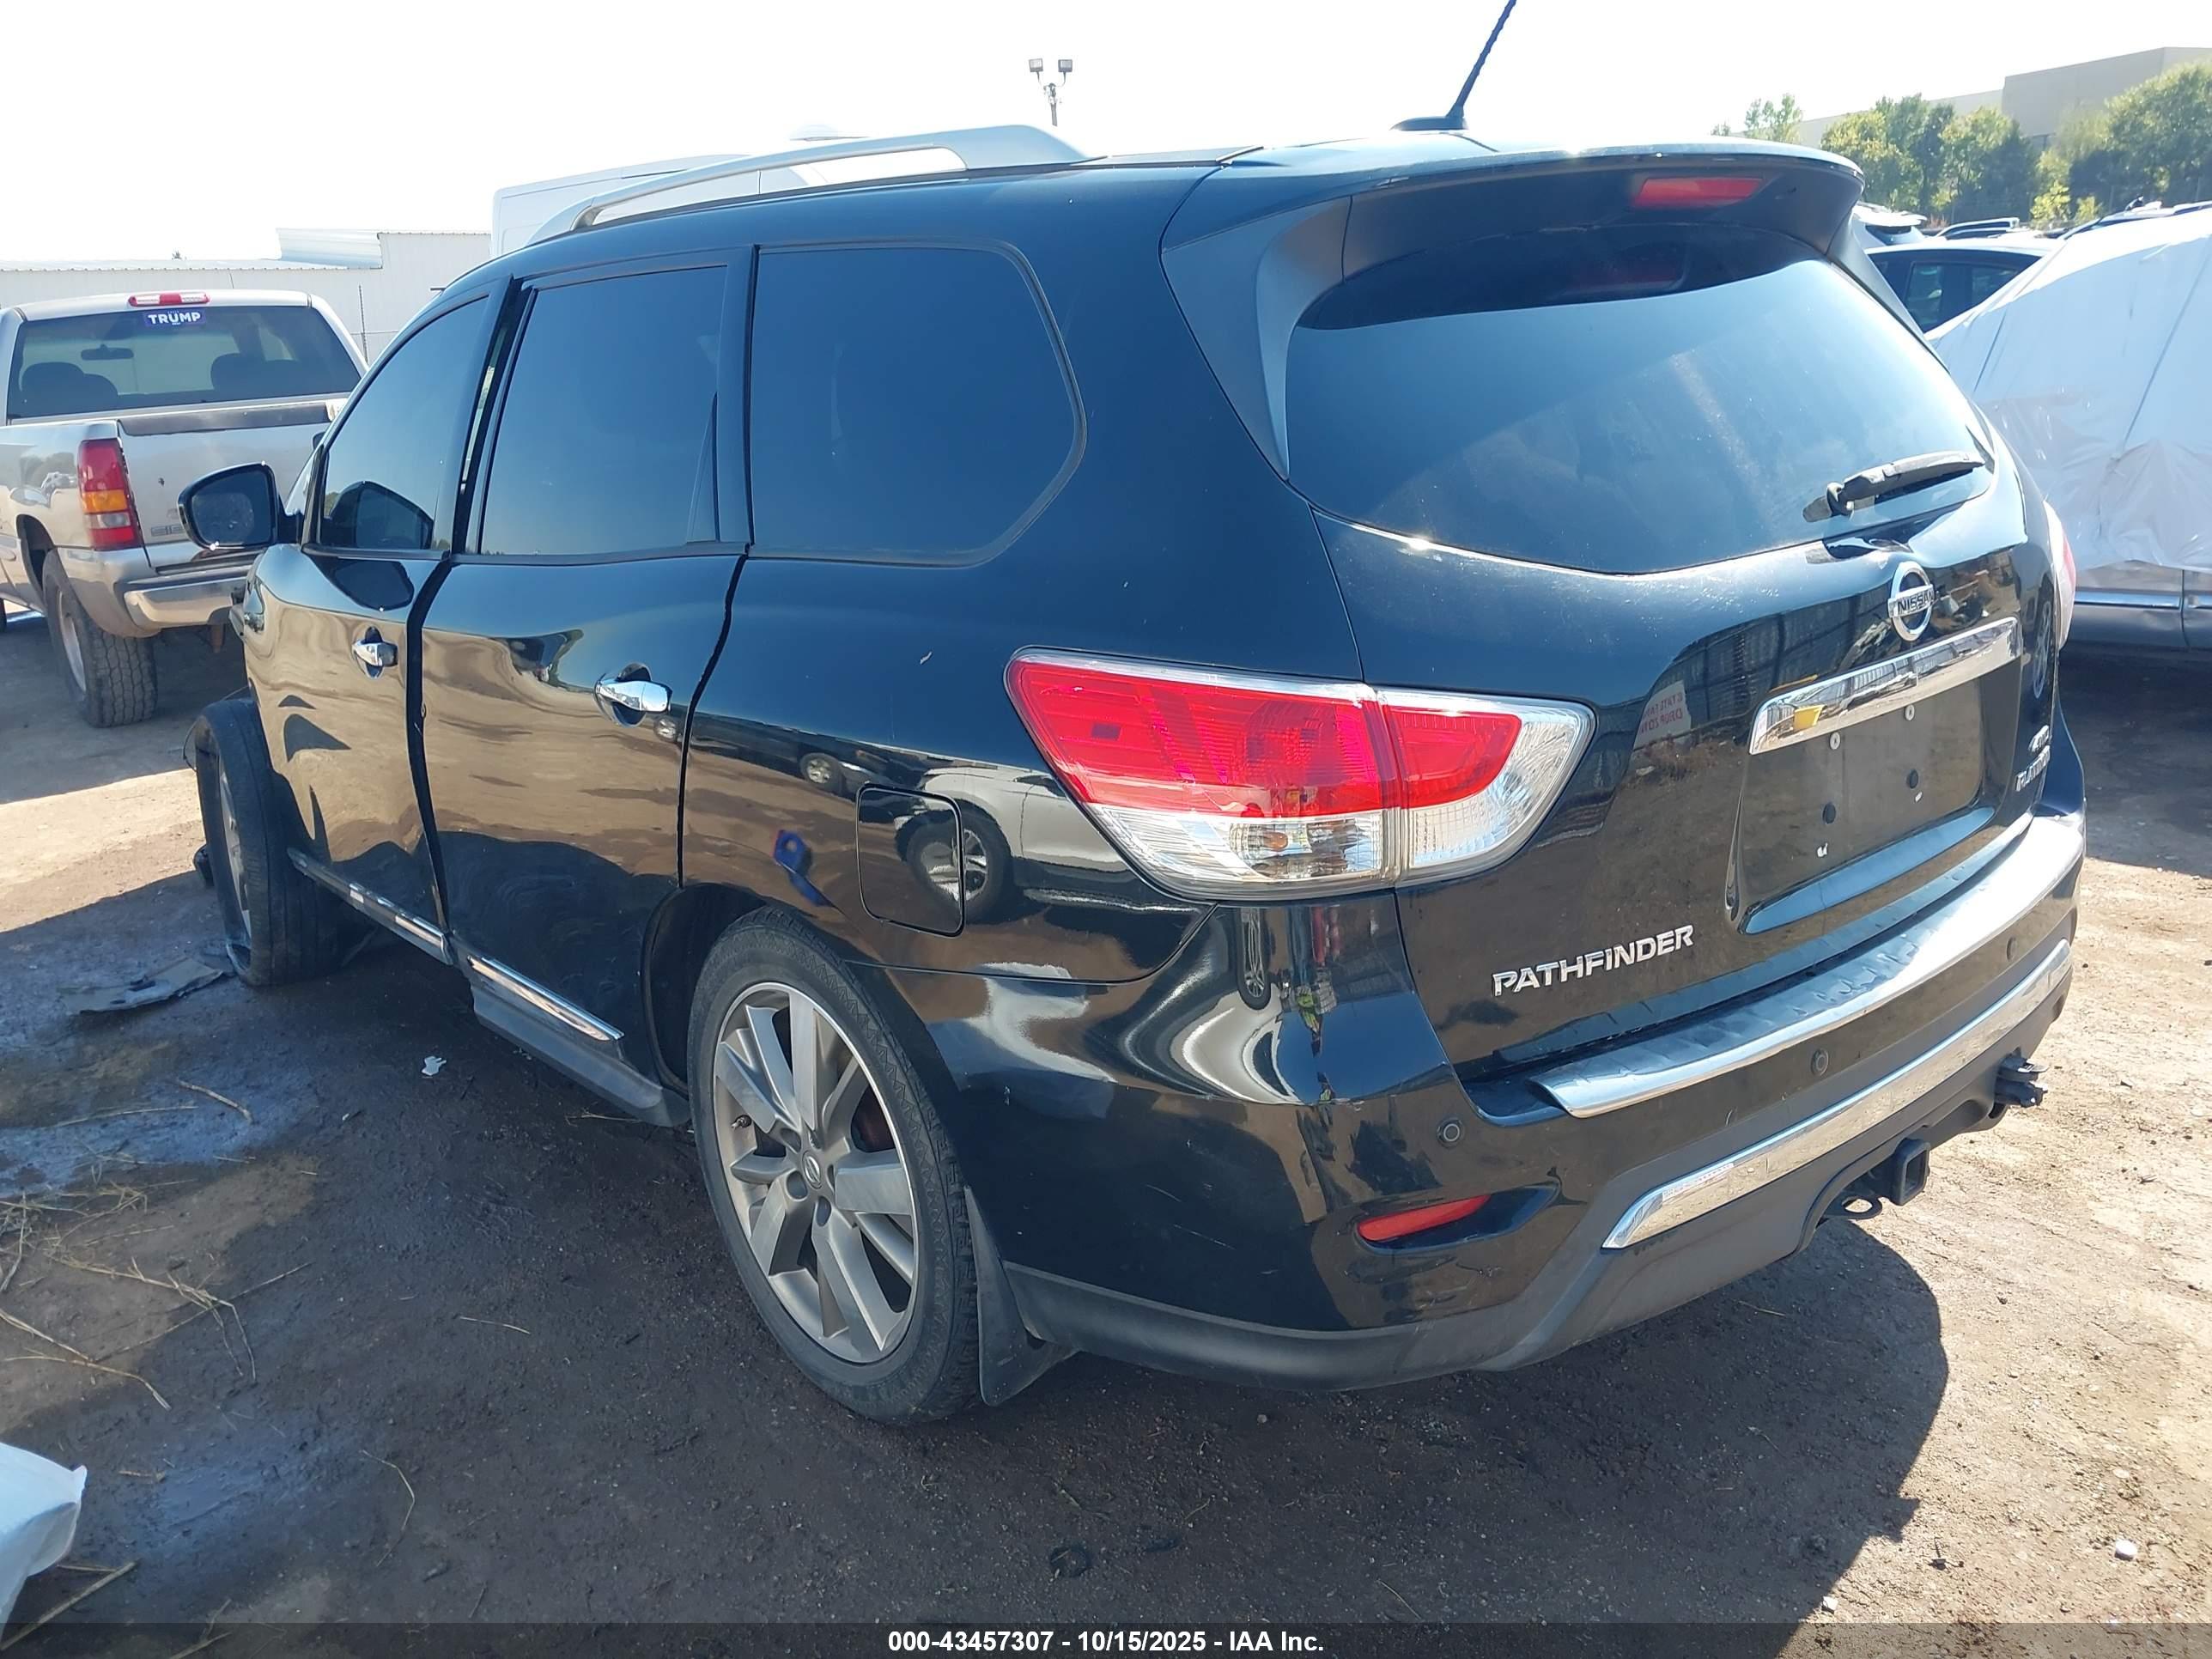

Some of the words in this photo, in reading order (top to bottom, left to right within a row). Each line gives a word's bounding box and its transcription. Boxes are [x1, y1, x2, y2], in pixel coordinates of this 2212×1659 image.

[148, 312, 201, 324] TRUMP
[1897, 587, 1934, 612] NISSAN
[1492, 925, 1693, 996] PATHFINDER
